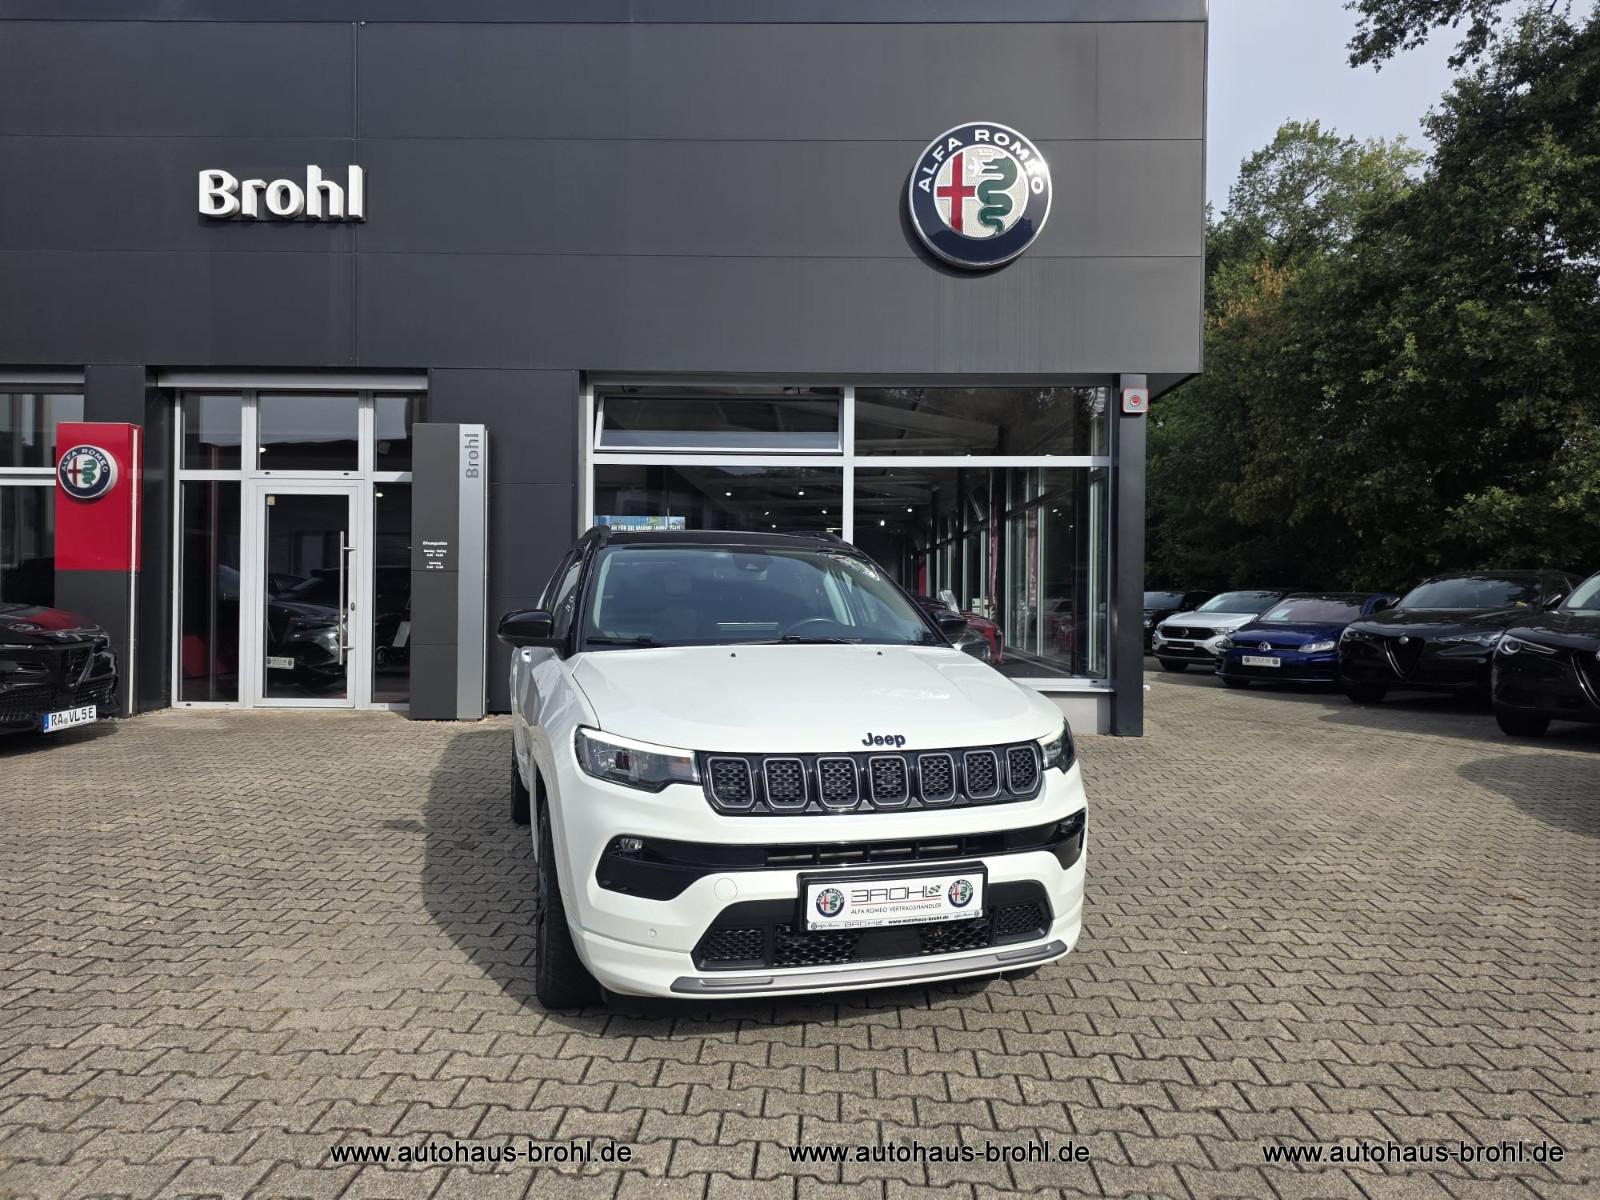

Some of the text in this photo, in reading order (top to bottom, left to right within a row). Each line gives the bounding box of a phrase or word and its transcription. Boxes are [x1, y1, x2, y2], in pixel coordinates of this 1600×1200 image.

[918, 129, 1044, 195] ALFA ROMEO
[199, 164, 364, 219] Brohl
[61, 448, 109, 473] ALFA ROMEO
[464, 433, 479, 479] Brohl
[861, 732, 906, 748] Jeep
[866, 906, 888, 914] ROMEO
